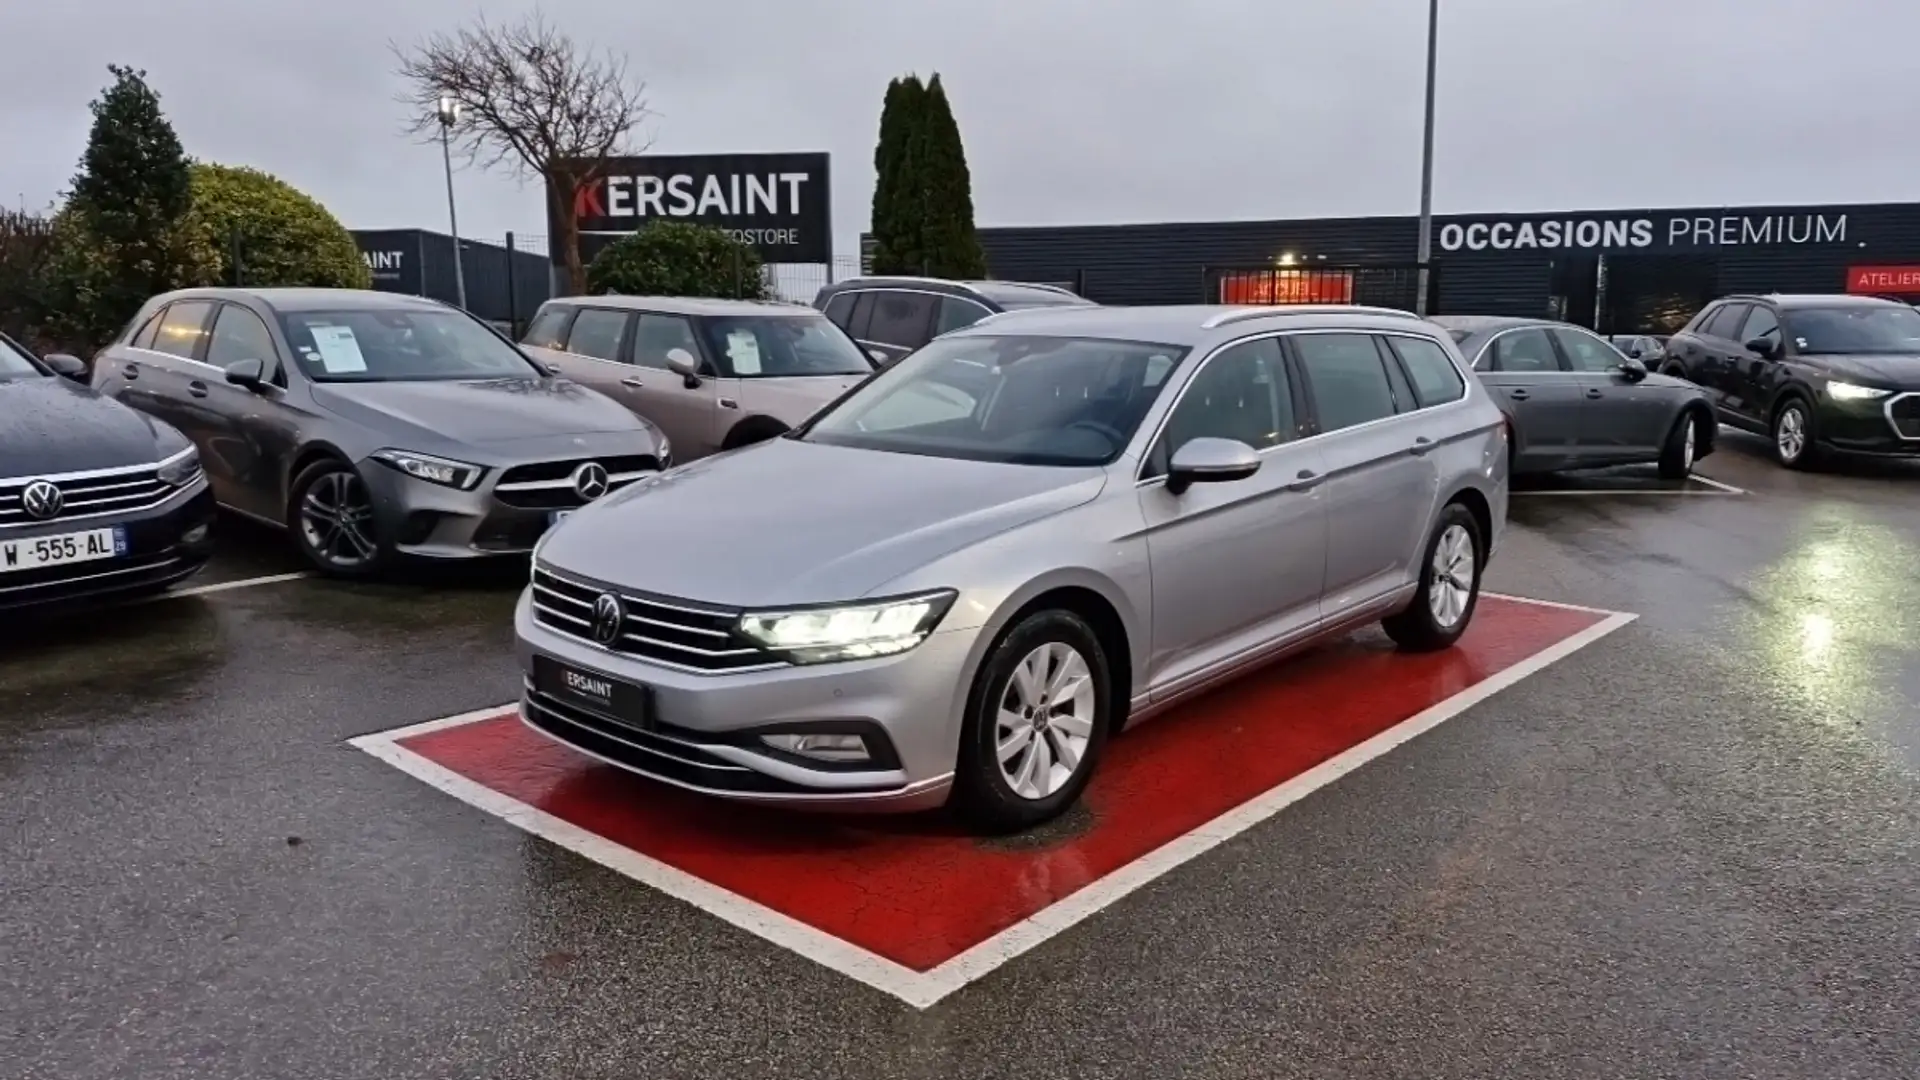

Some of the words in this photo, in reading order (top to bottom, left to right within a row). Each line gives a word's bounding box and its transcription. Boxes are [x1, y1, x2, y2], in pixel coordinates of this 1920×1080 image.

[574, 172, 809, 216] KERSAINT
[720, 228, 799, 245] OSTORE
[1440, 219, 1653, 250] OCCASIONS
[1668, 214, 1847, 246] PREMIUM
[362, 251, 404, 269] AINT
[1858, 272, 1920, 286] ATELIER
[562, 669, 613, 698] ERSAINT
